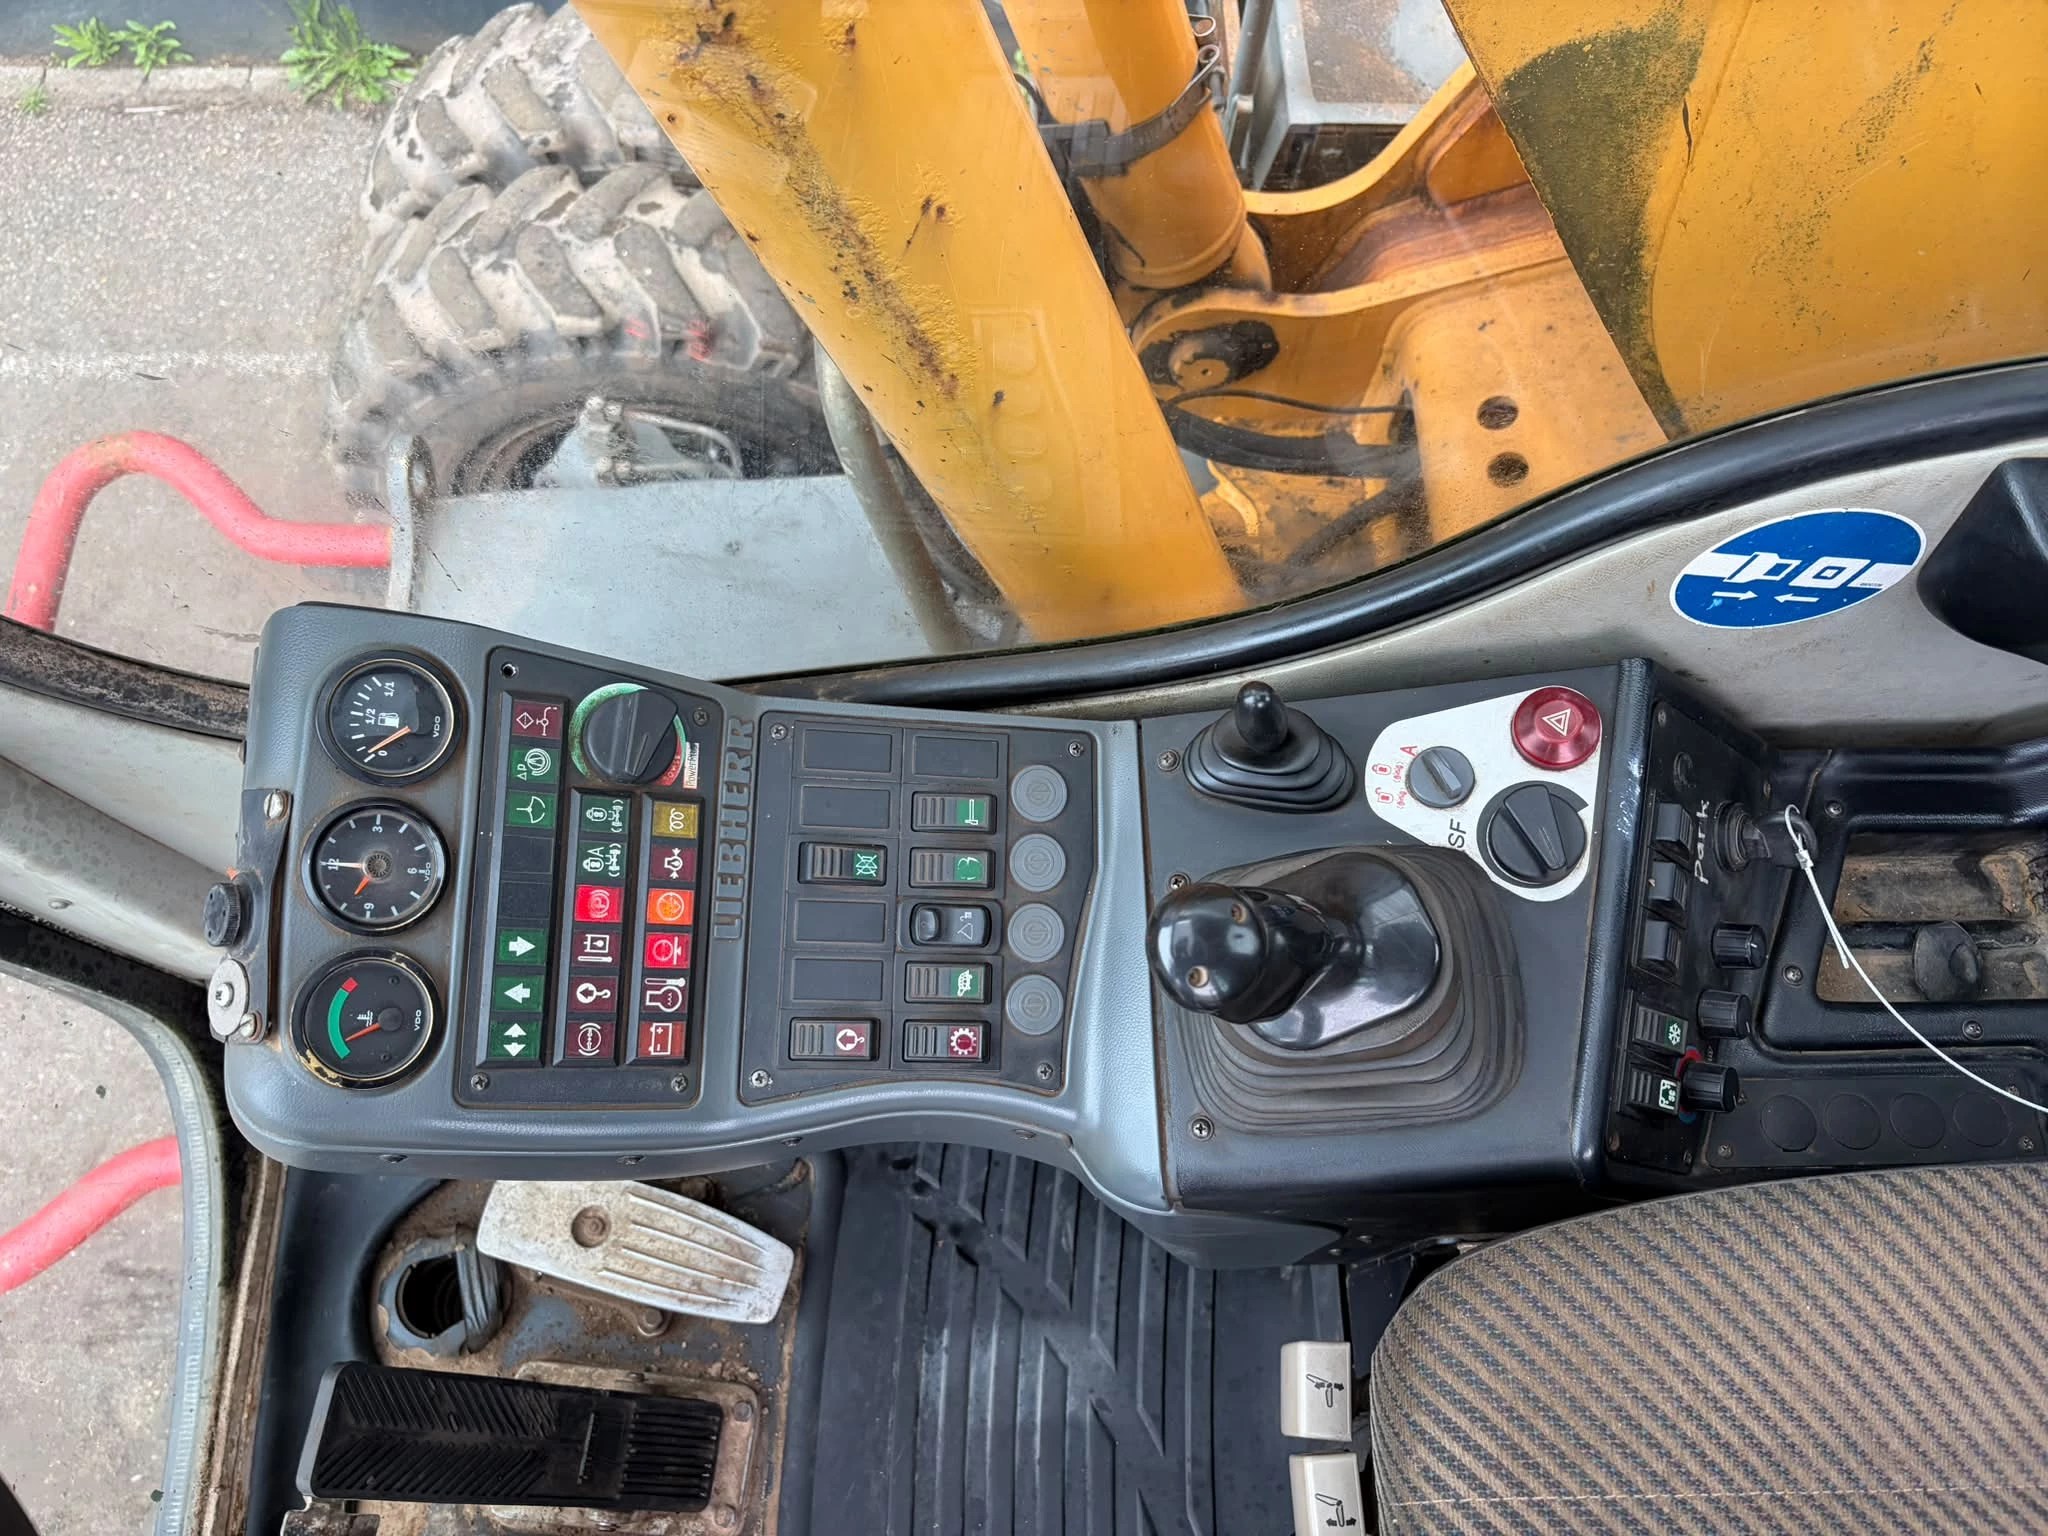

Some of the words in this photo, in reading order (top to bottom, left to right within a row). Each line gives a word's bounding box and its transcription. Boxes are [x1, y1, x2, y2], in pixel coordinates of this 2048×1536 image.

[384, 681, 395, 697] 1/1
[365, 708, 376, 725] 1/2
[432, 716, 441, 738] VDO
[1400, 745, 1418, 757] A
[372, 825, 383, 833] 3
[712, 716, 755, 941] LIEBHERR
[1448, 818, 1467, 849] SF
[1694, 799, 1710, 885] Park
[407, 867, 417, 875] 6
[364, 902, 375, 910] 9
[414, 1009, 422, 1031] VDO
